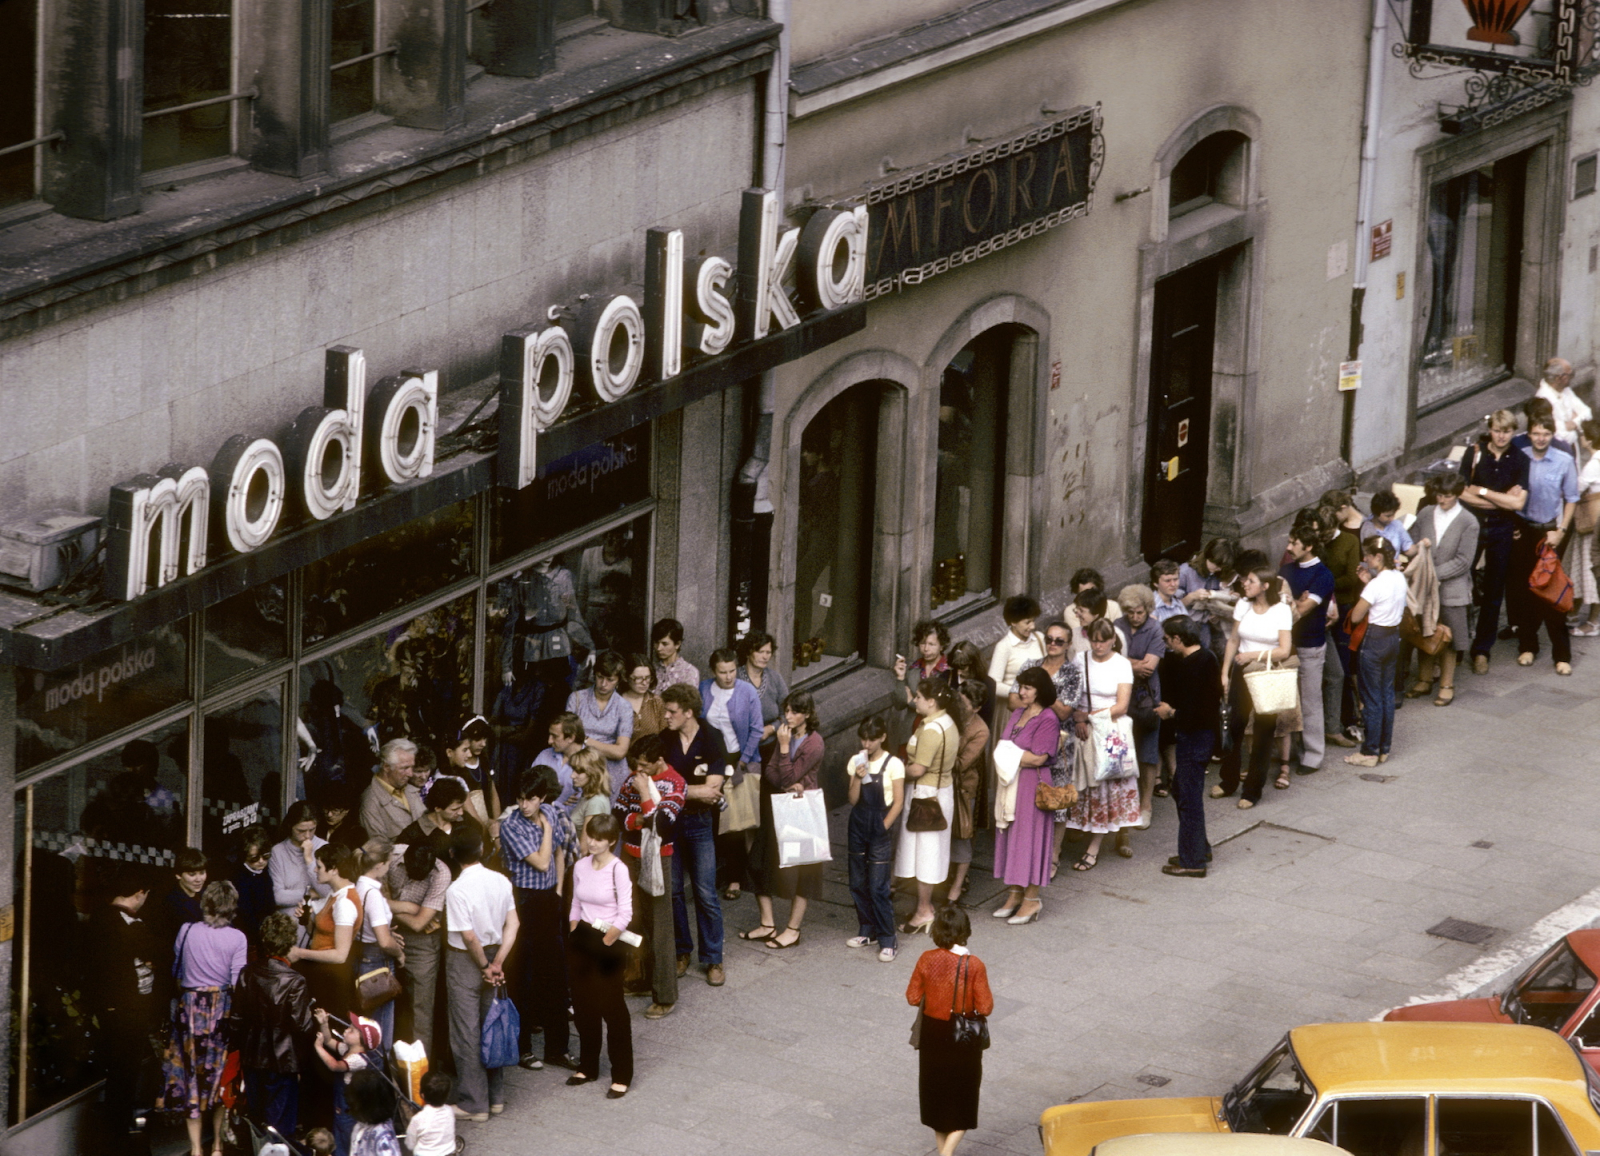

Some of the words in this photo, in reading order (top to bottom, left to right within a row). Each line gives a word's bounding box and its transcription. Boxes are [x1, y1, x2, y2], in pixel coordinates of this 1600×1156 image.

[866, 134, 1078, 273] MFORA
[126, 348, 439, 601] moda
[517, 190, 869, 490] polska
[547, 457, 587, 500] moda
[590, 440, 638, 493] polska
[45, 664, 94, 712] moda
[99, 645, 155, 703] polska
